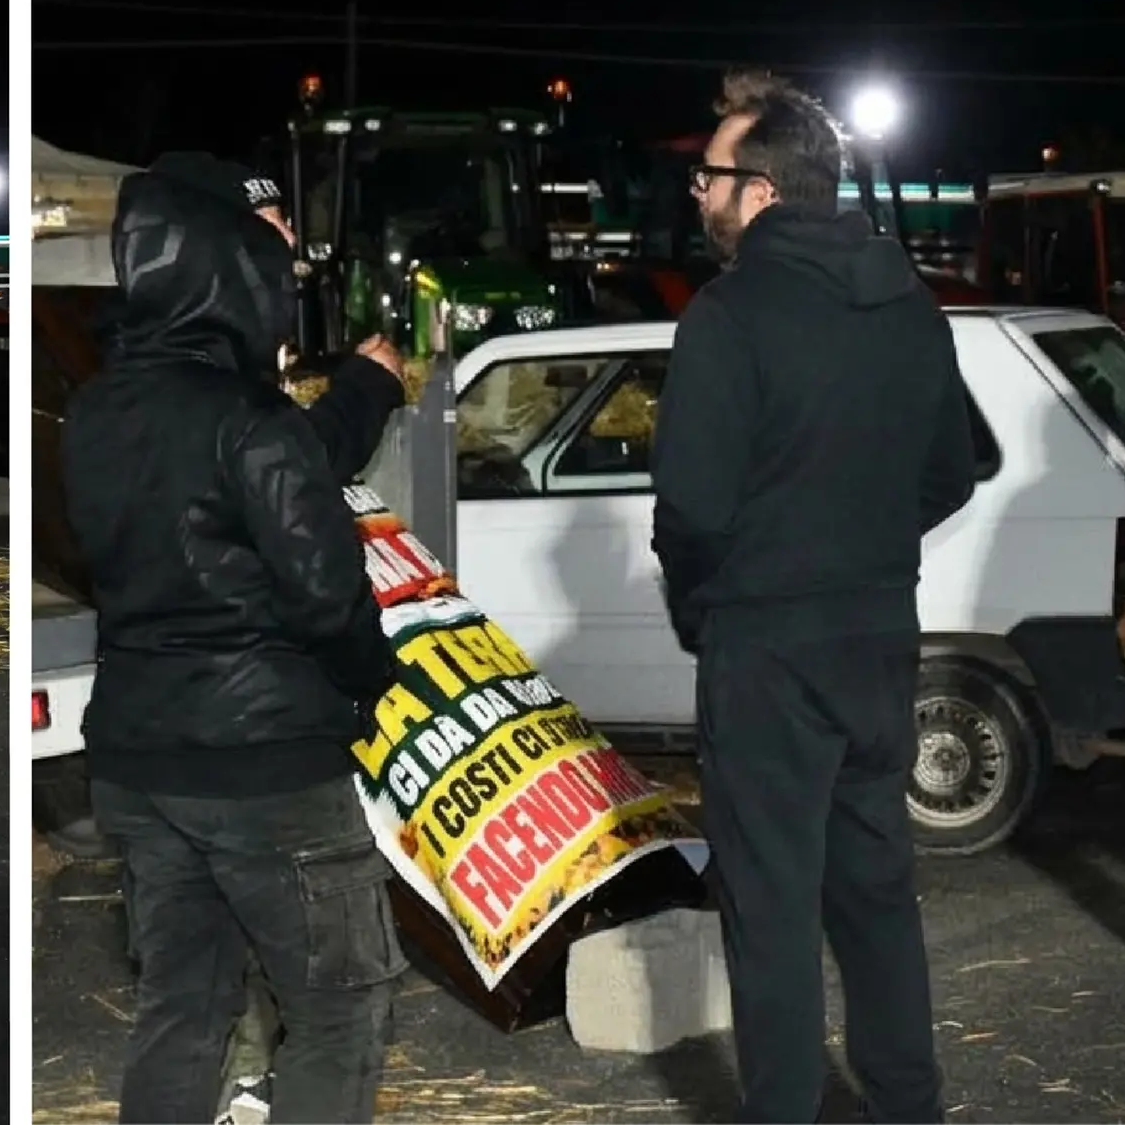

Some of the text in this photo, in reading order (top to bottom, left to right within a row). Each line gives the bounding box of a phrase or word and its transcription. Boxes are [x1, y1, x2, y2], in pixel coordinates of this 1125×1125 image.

[388, 751, 430, 806] CI
[460, 687, 518, 732] DA
[431, 743, 523, 839] COSTI
[512, 725, 551, 761] CI
[420, 823, 447, 859] I
[449, 759, 611, 929] FACENDO
